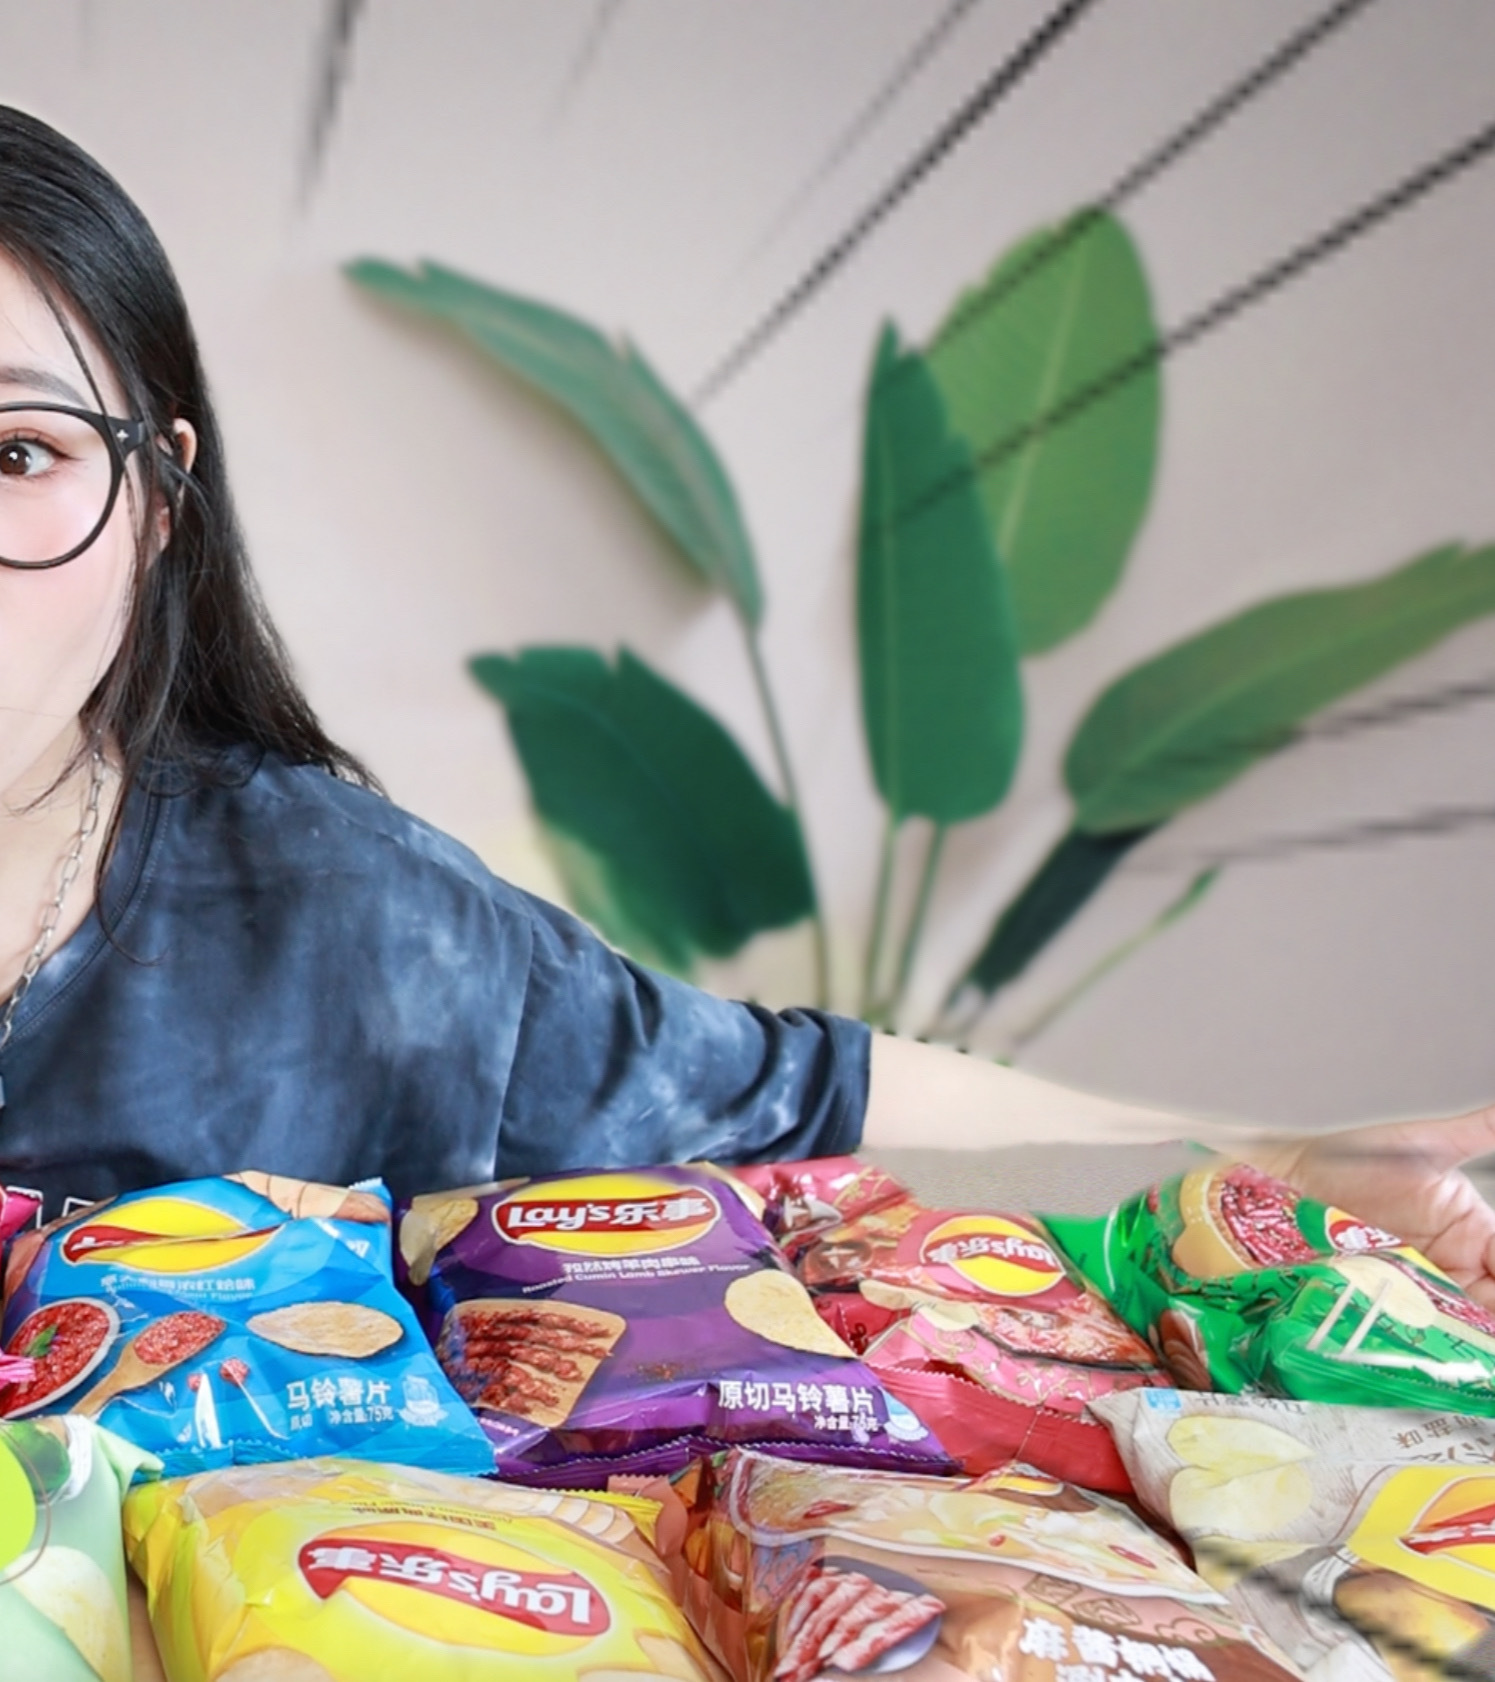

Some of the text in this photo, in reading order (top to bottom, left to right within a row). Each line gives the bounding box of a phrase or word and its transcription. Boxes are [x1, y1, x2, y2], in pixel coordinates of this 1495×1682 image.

[507, 1196, 711, 1231] Lay's乐事
[286, 1375, 391, 1412] 马铃薯片
[718, 1380, 874, 1415] 原切马铃薯片
[307, 1546, 592, 1625] Lay's乐事
